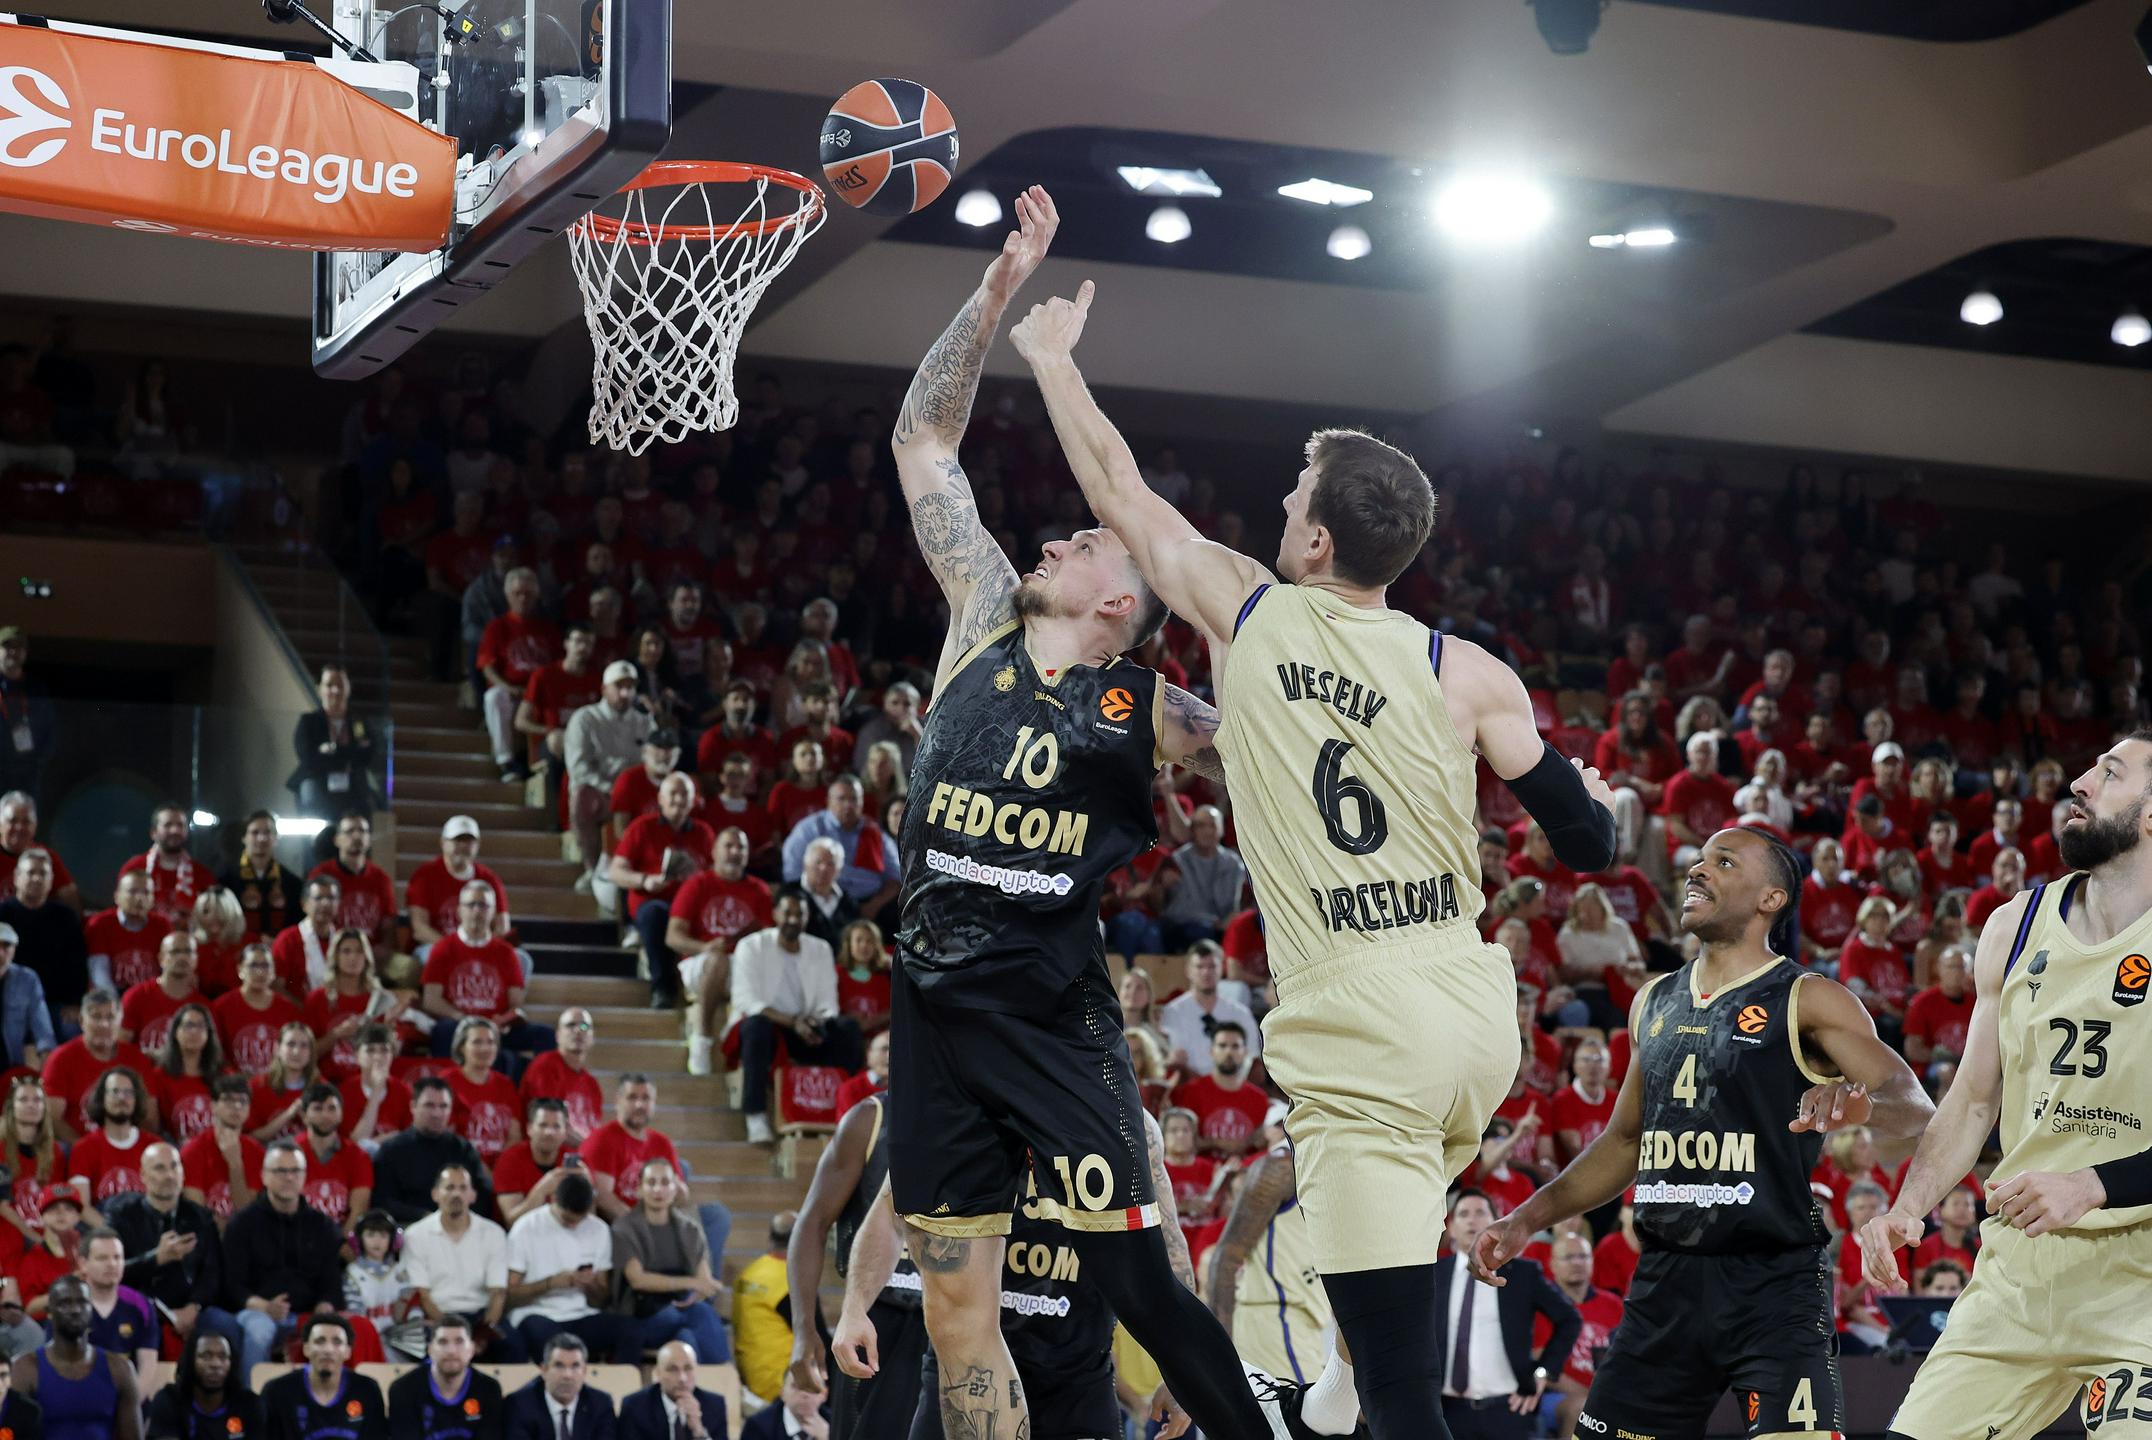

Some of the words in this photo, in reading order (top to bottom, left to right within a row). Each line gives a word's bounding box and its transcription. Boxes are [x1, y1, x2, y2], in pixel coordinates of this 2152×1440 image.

[91, 108, 419, 204] EuroLeague
[1277, 662, 1387, 729] VESELY
[1095, 721, 1129, 736] EuroLeague
[1003, 725, 1059, 789] 10
[926, 781, 1089, 857] FEDCOM
[1312, 738, 1389, 856] 6
[2114, 991, 2144, 1001] EuroLeague
[1675, 1025, 1709, 1036] SPALDING
[2049, 1017, 2111, 1078] 23
[1672, 1054, 1697, 1109] 4
[2051, 1117, 2117, 1140] Sanitària
[2053, 1100, 2142, 1131] Assistència
[1053, 1153, 1114, 1212] 10
[969, 1382, 988, 1398] 27
[1787, 1377, 1818, 1431] 4
